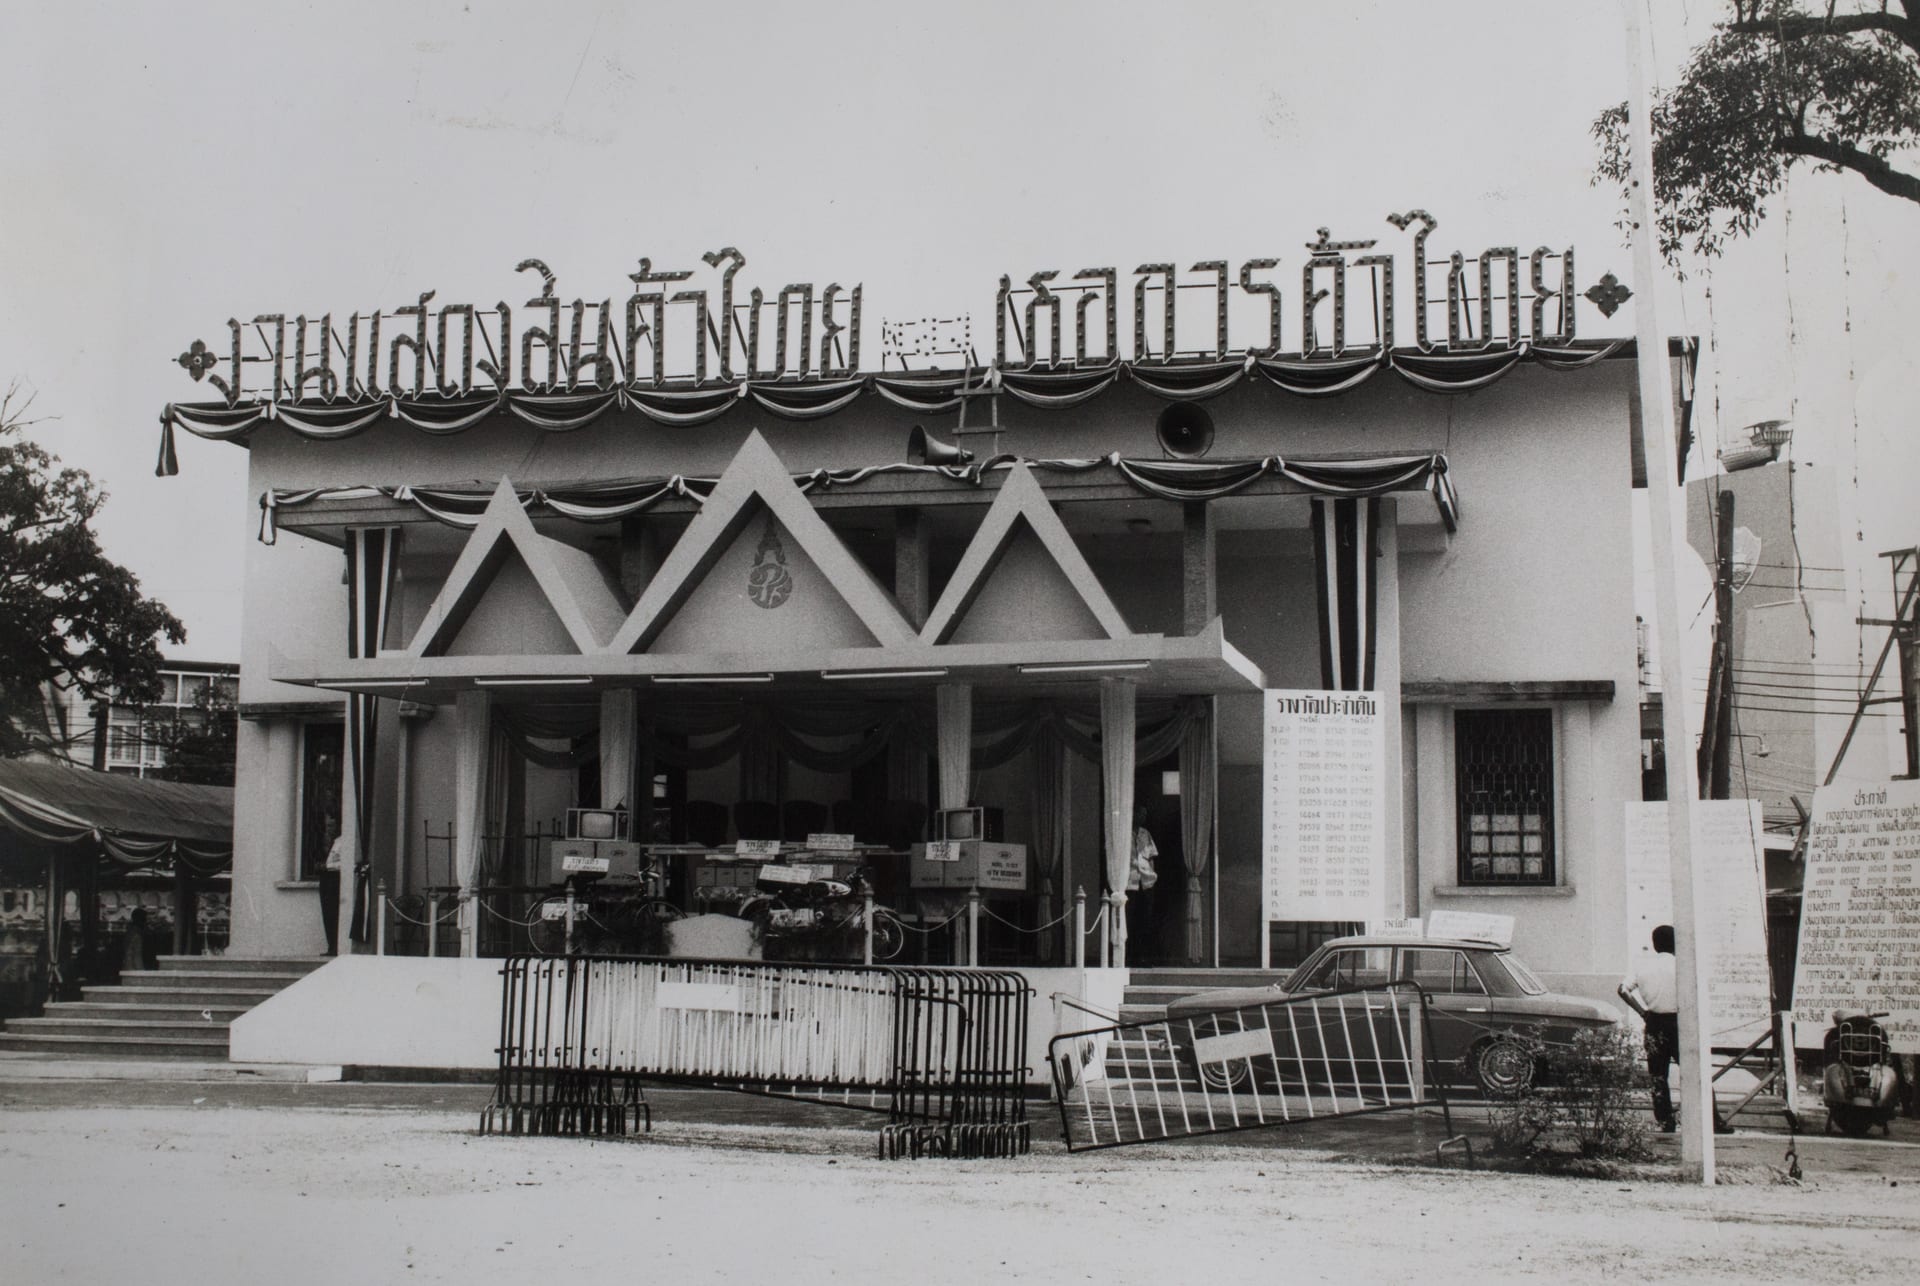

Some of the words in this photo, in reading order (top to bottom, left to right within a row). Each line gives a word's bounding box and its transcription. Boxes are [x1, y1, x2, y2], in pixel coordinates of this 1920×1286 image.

[209, 247, 863, 408] งานแสดงสินค้าไทย
[996, 210, 1575, 370] หอการค้าไทย
[1277, 694, 1376, 715] รางวัลประจำคืน
